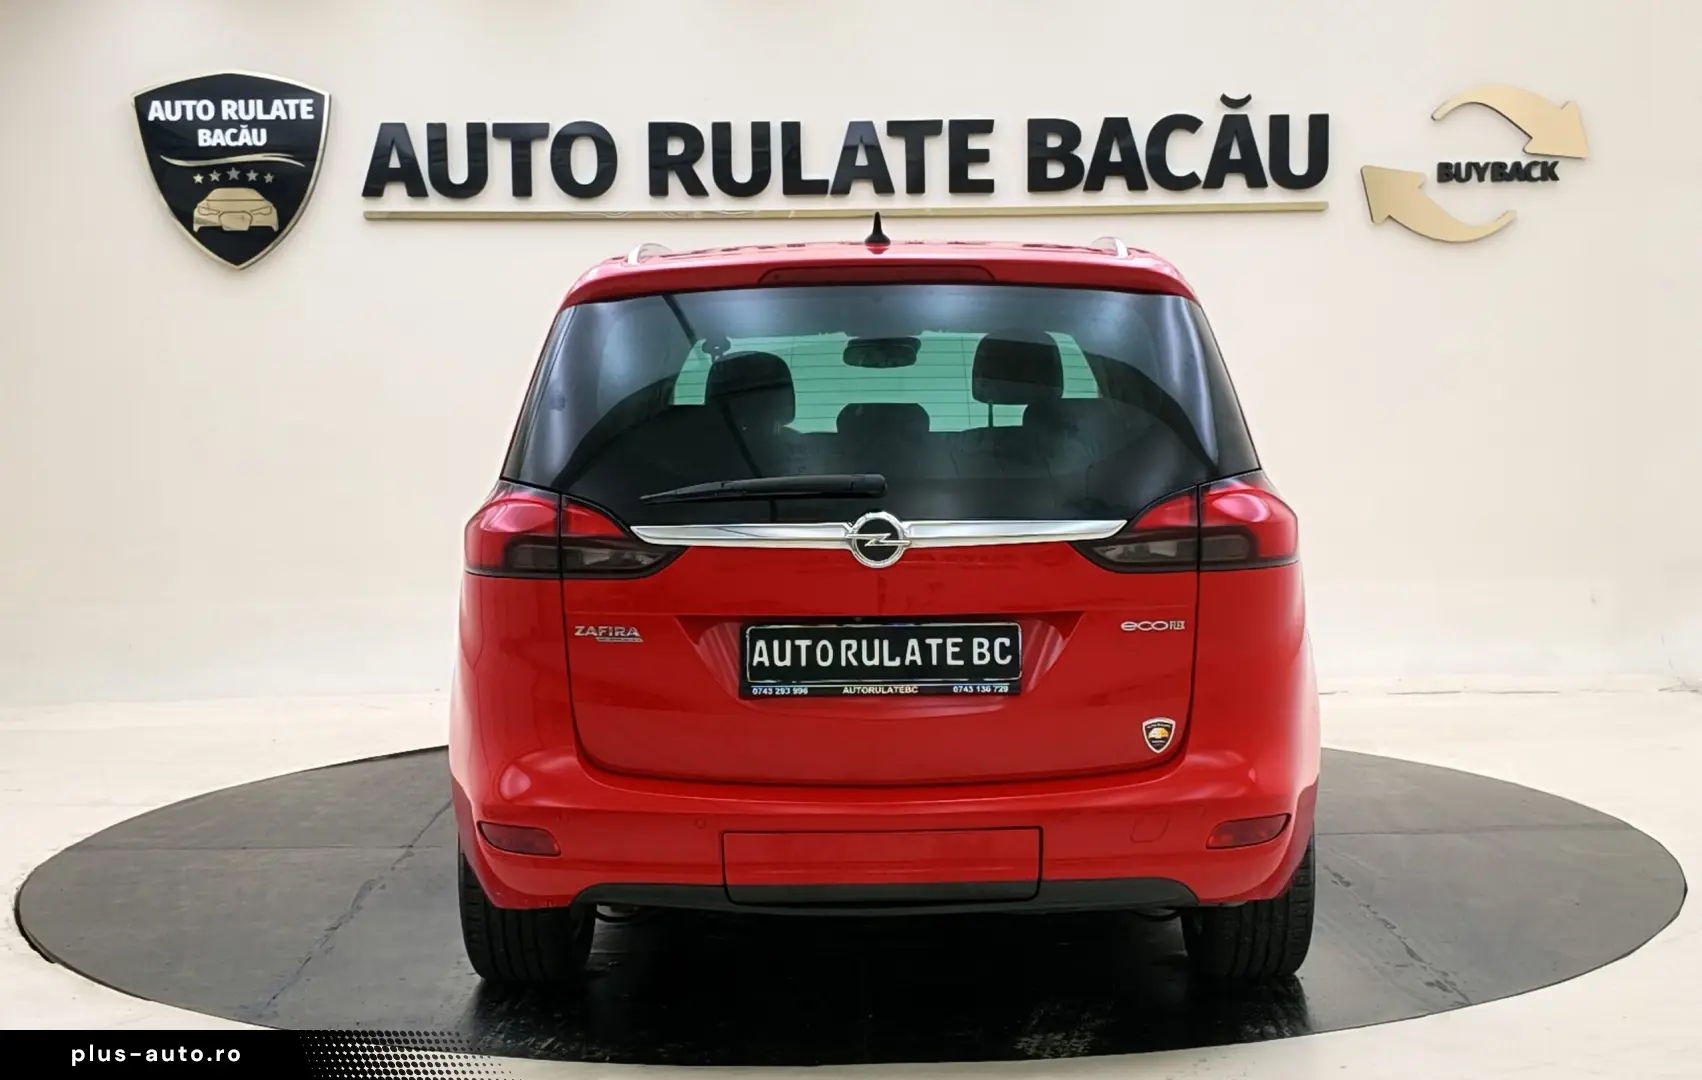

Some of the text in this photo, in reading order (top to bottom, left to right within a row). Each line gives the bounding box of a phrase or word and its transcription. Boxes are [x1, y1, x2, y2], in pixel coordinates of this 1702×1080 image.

[148, 98, 315, 121] AUTO RULATE
[197, 124, 268, 147] BACĂU
[361, 93, 1330, 199] AUTO RULATE BACĂU
[1437, 160, 1560, 183] BUYBACK
[574, 625, 641, 637] ZAFIRA
[752, 637, 1013, 667] AUTO RULATE BC
[752, 687, 773, 695] 0743
[775, 687, 791, 695] 293
[842, 685, 919, 695] AUTORULATEBC
[953, 685, 974, 693] 0743
